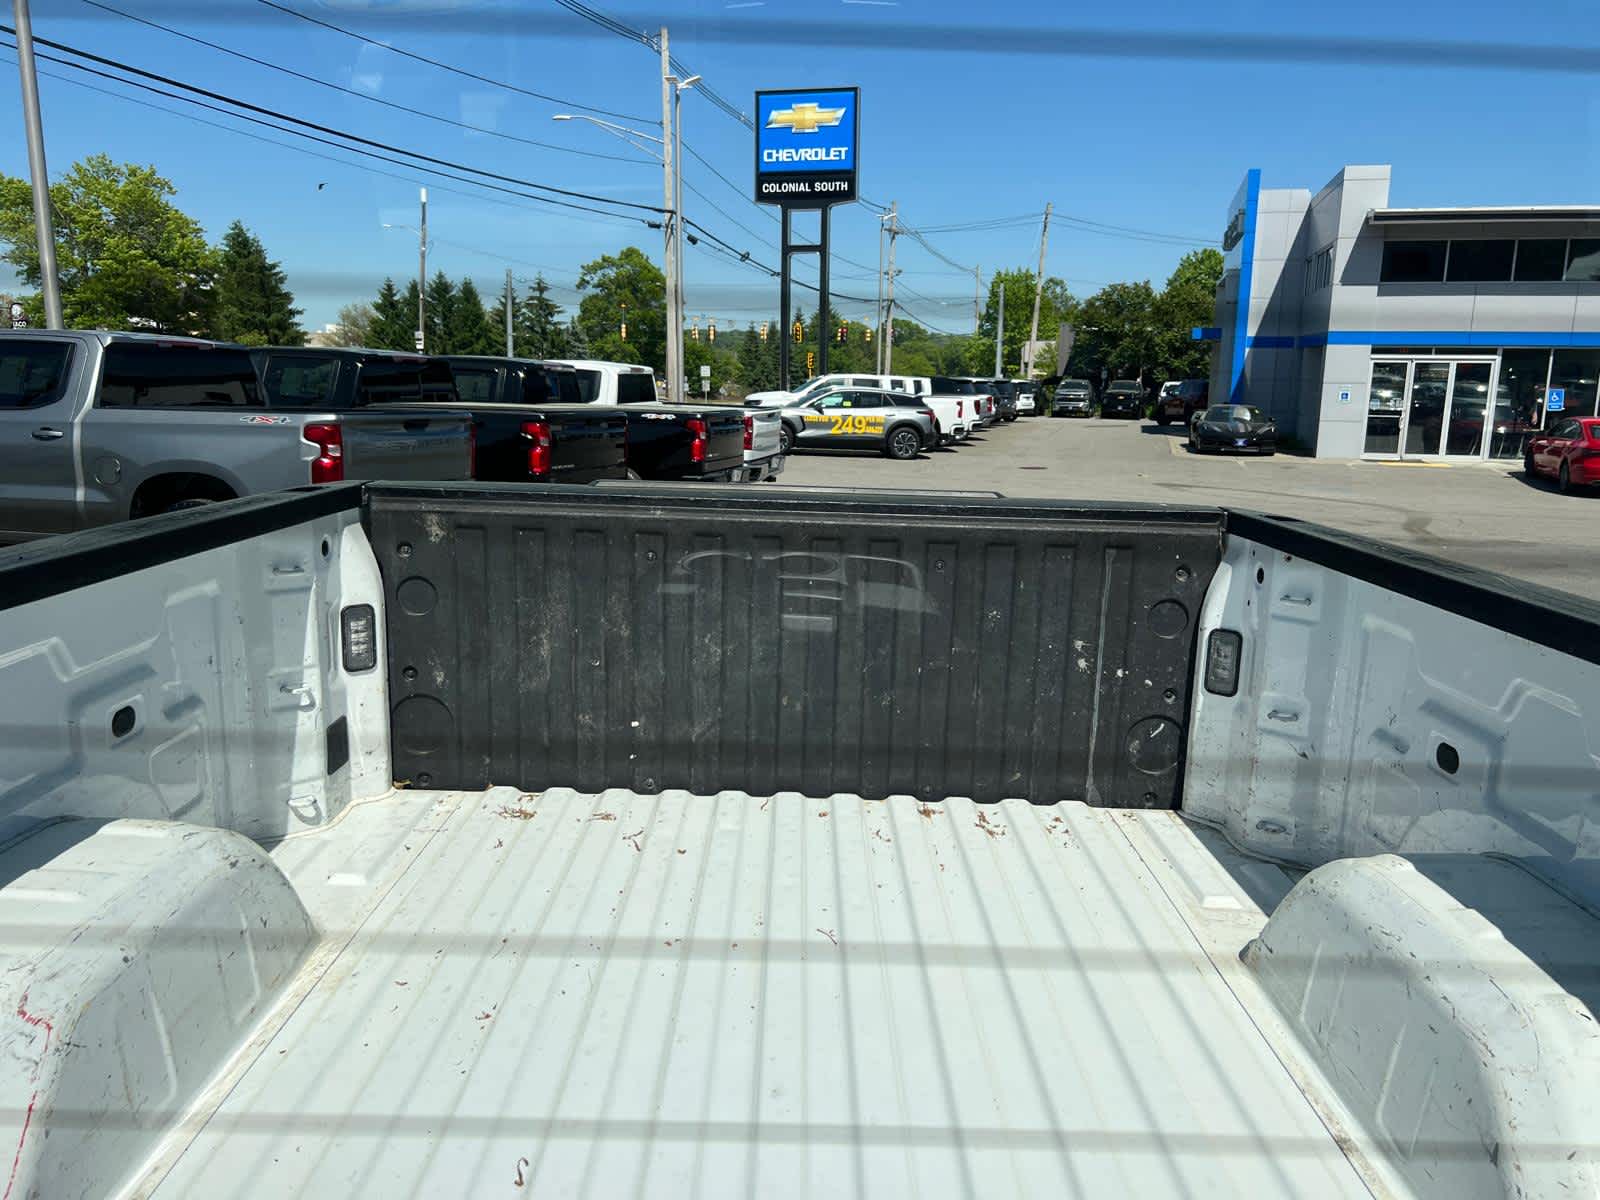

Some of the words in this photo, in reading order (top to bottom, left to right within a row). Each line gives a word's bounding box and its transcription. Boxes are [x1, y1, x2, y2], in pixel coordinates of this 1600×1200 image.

[763, 147, 848, 162] CHEVROLET
[762, 182, 811, 192] COLONIAL
[814, 181, 848, 191] SOUTH
